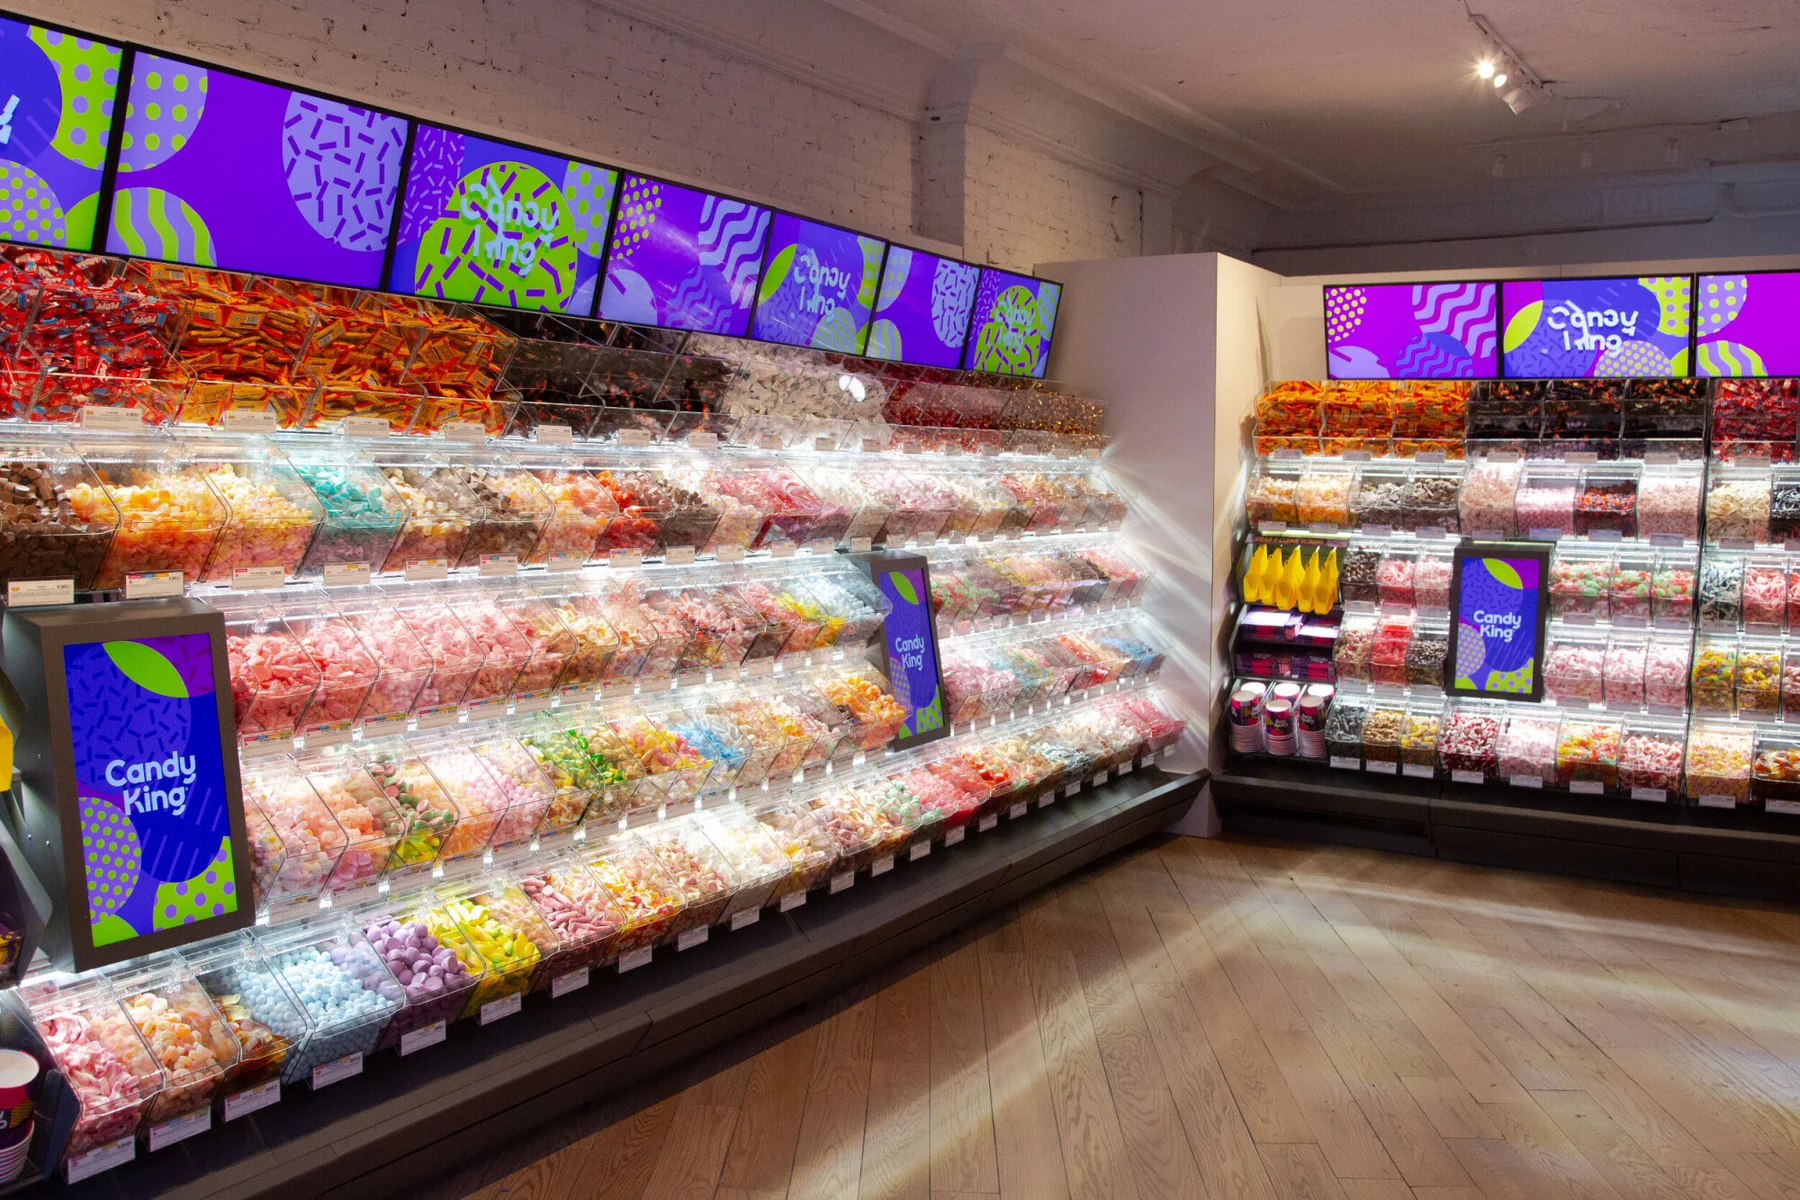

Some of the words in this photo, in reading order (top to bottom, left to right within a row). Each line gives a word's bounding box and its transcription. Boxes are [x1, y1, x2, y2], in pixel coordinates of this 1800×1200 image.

[1473, 610, 1522, 629] Candy
[1480, 624, 1514, 643] King
[895, 634, 925, 653] Candy
[901, 652, 924, 671] King
[105, 750, 197, 787] Candy
[122, 785, 187, 816] King
